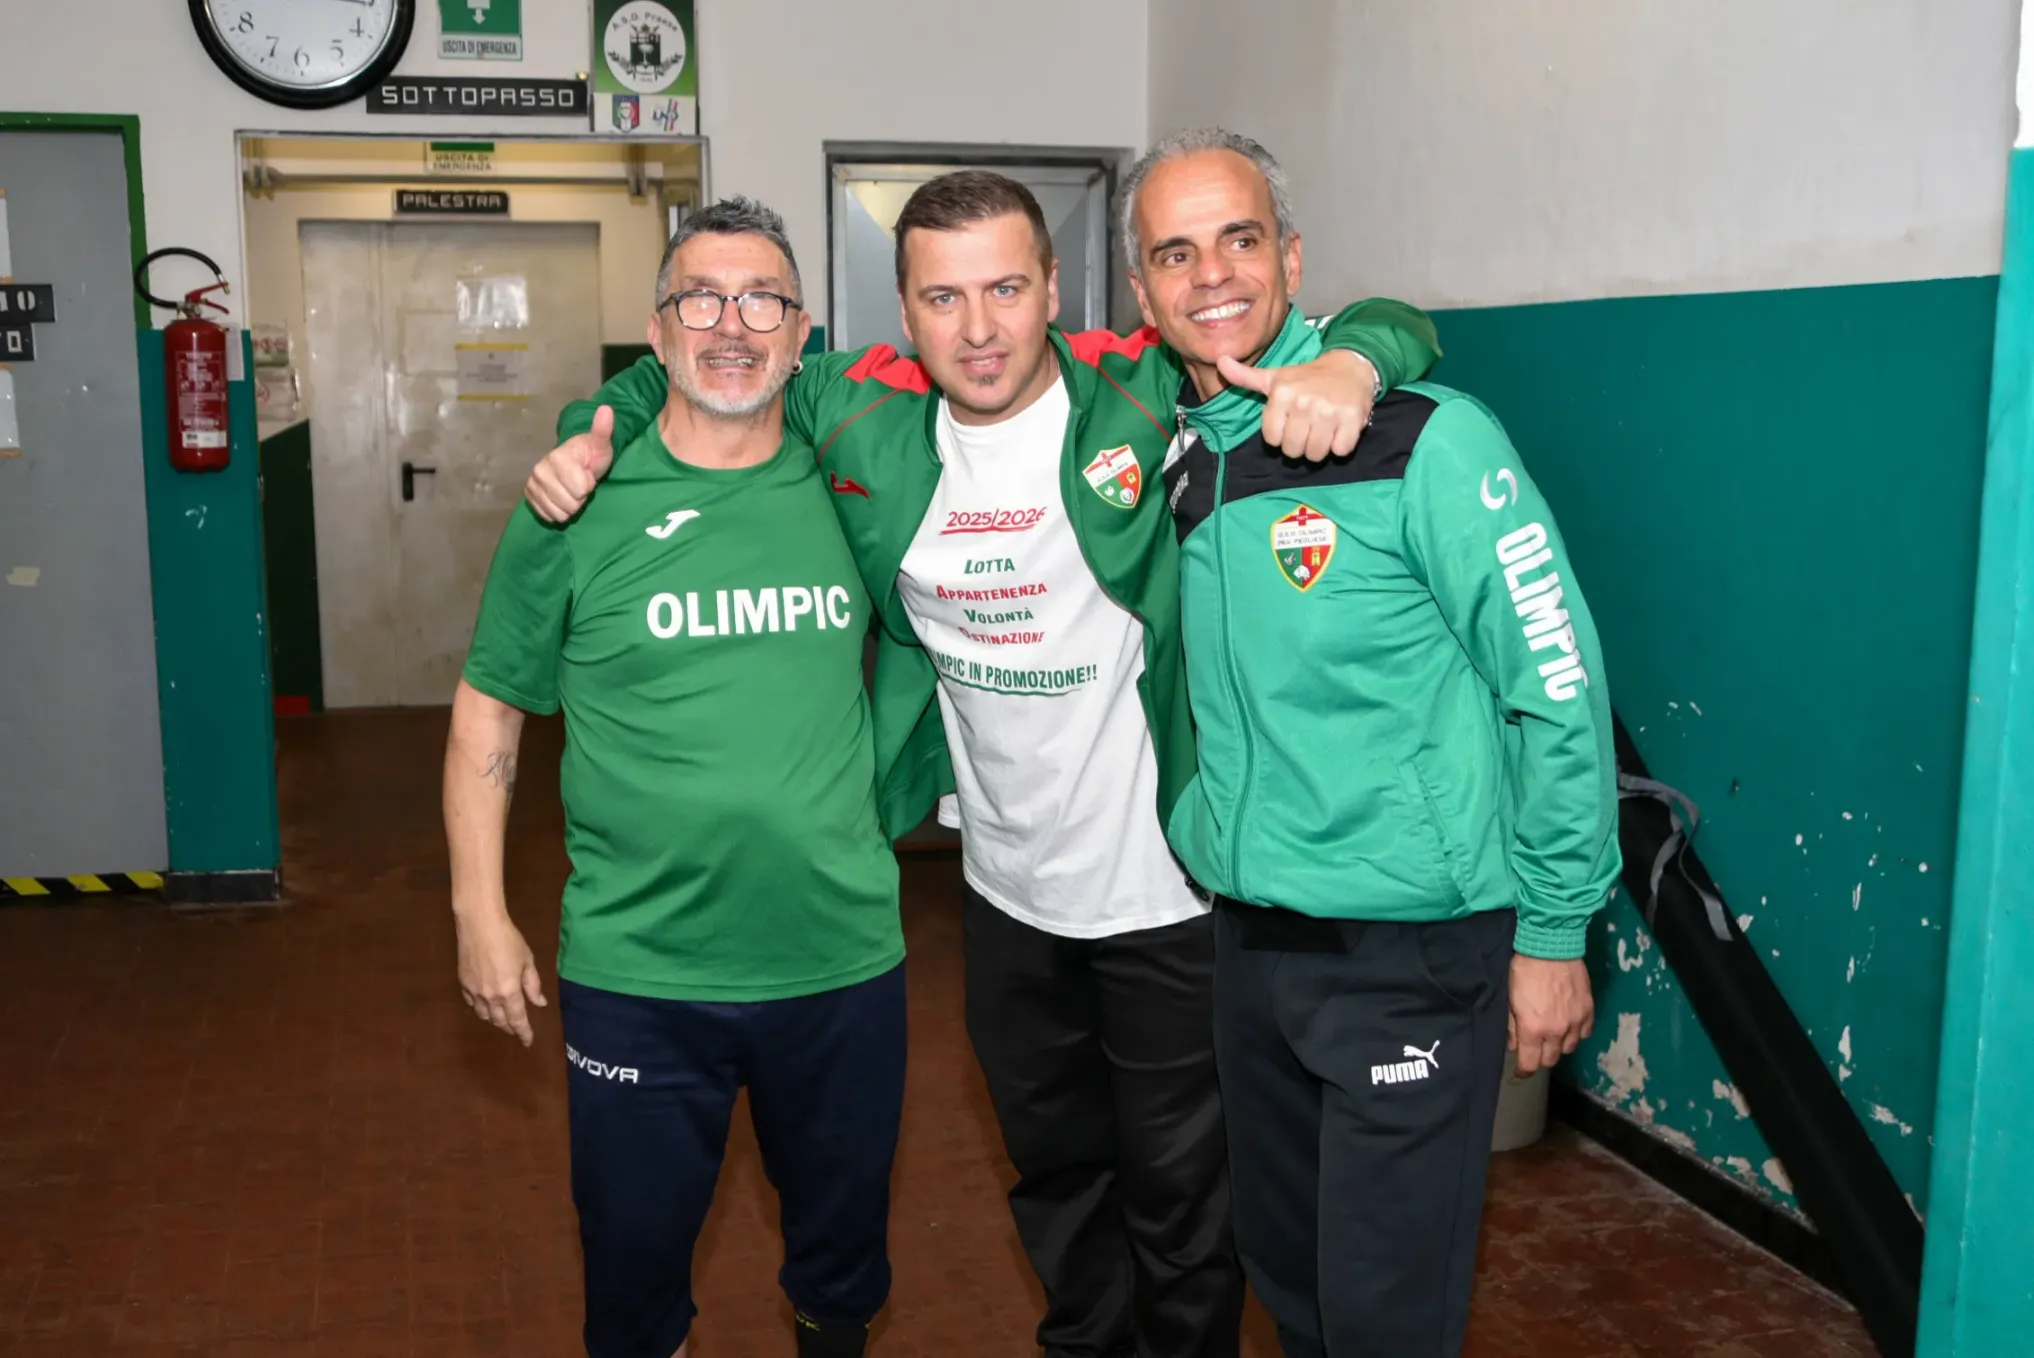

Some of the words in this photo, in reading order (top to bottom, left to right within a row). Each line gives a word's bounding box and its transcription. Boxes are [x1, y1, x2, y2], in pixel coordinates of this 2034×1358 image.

[238, 11, 254, 34] 8
[349, 17, 364, 37] 4
[265, 35, 279, 58] 7
[294, 45, 310, 69] 6
[329, 39, 344, 61] 5
[442, 40, 467, 54] USCITA
[467, 41, 475, 54] DI
[476, 41, 518, 56] EMERGENZA
[381, 86, 575, 107] SOTTOPASSO
[432, 162, 492, 171] EMERGENZA
[435, 154, 475, 162] USCITA
[402, 193, 501, 208] PALESTRA
[946, 506, 1047, 528] 2025/2026
[646, 585, 851, 639] OLIMPIC
[1495, 522, 1589, 702] OLIMPIC
[969, 661, 982, 681] IN
[986, 664, 1098, 689] PROMOZIONE!!
[1371, 1059, 1429, 1085] PUMA
